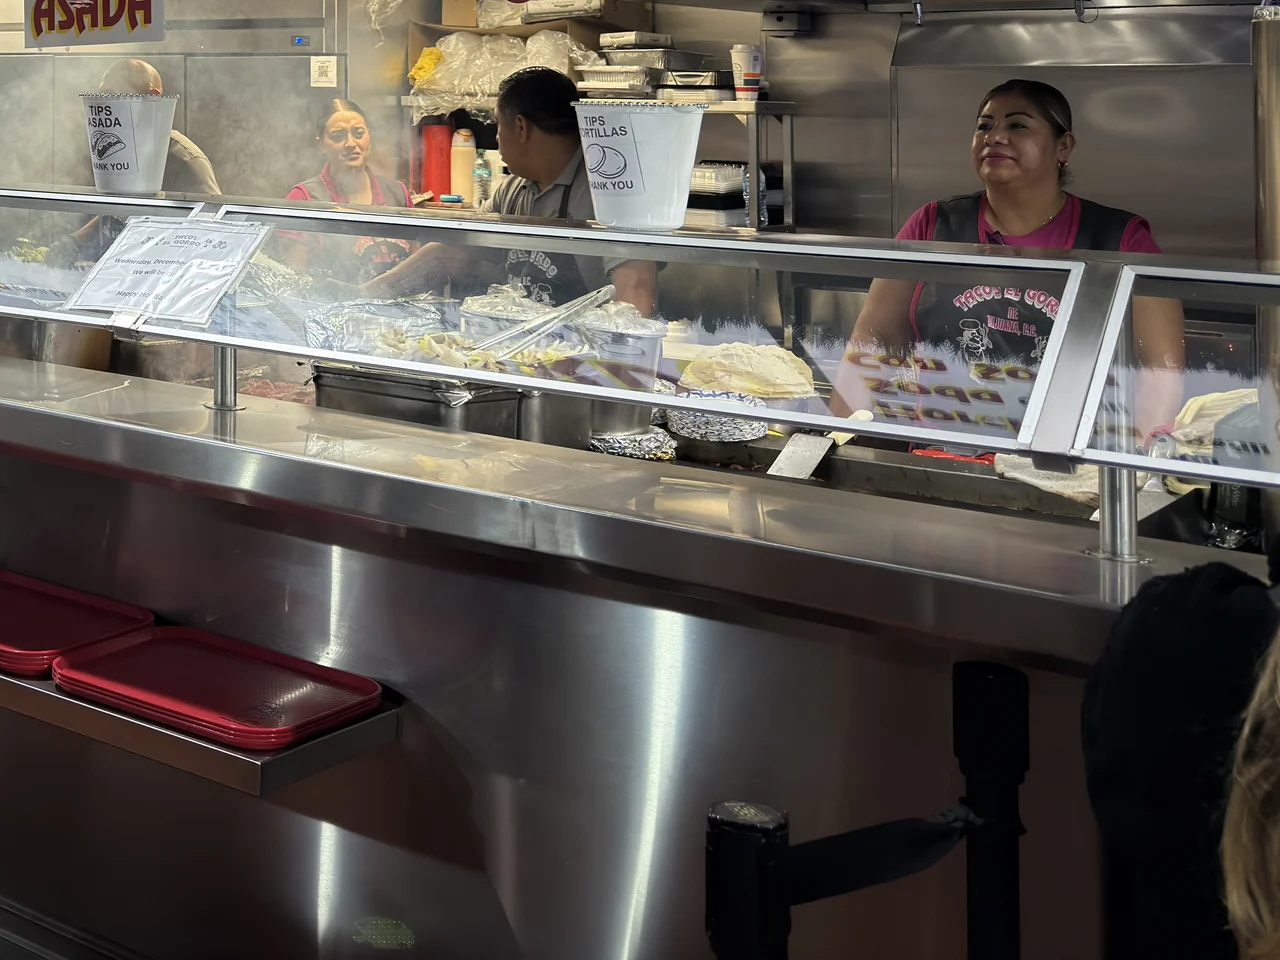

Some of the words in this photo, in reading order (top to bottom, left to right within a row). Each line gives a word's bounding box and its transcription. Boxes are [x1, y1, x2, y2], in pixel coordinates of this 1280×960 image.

[89, 105, 112, 117] TIPS
[88, 117, 122, 128] ASADA
[584, 115, 606, 127] TIPS
[110, 162, 130, 171] YOU
[610, 180, 634, 190] YOU
[952, 285, 1002, 312] TACOS
[1008, 307, 1019, 319] DE
